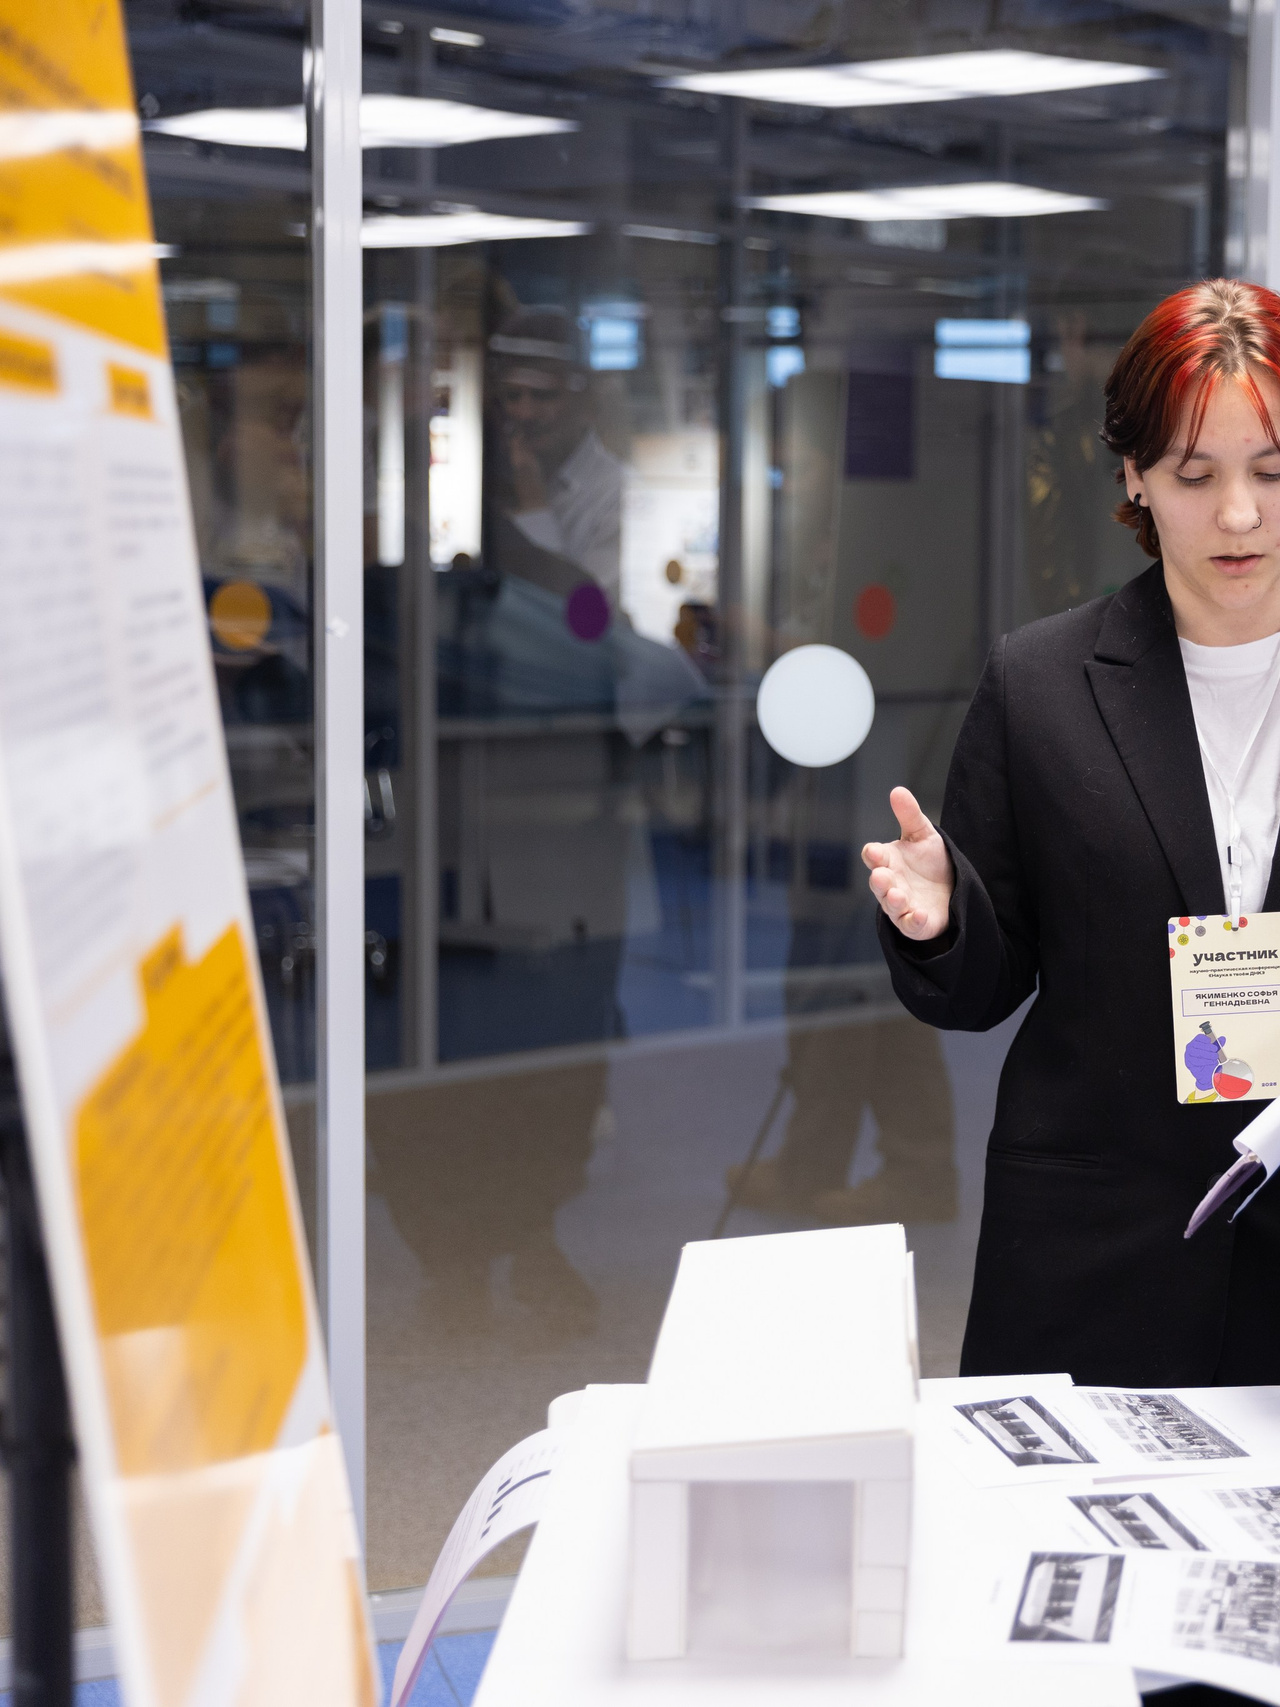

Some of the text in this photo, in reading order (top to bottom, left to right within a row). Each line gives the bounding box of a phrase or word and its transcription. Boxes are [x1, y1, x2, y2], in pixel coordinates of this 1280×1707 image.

[1193, 949, 1279, 967] участник
[1195, 990, 1279, 1000] ЯКИМЕНКО СОФЬЯ
[1203, 998, 1271, 1008] ГЕННАДЬЕВНА
